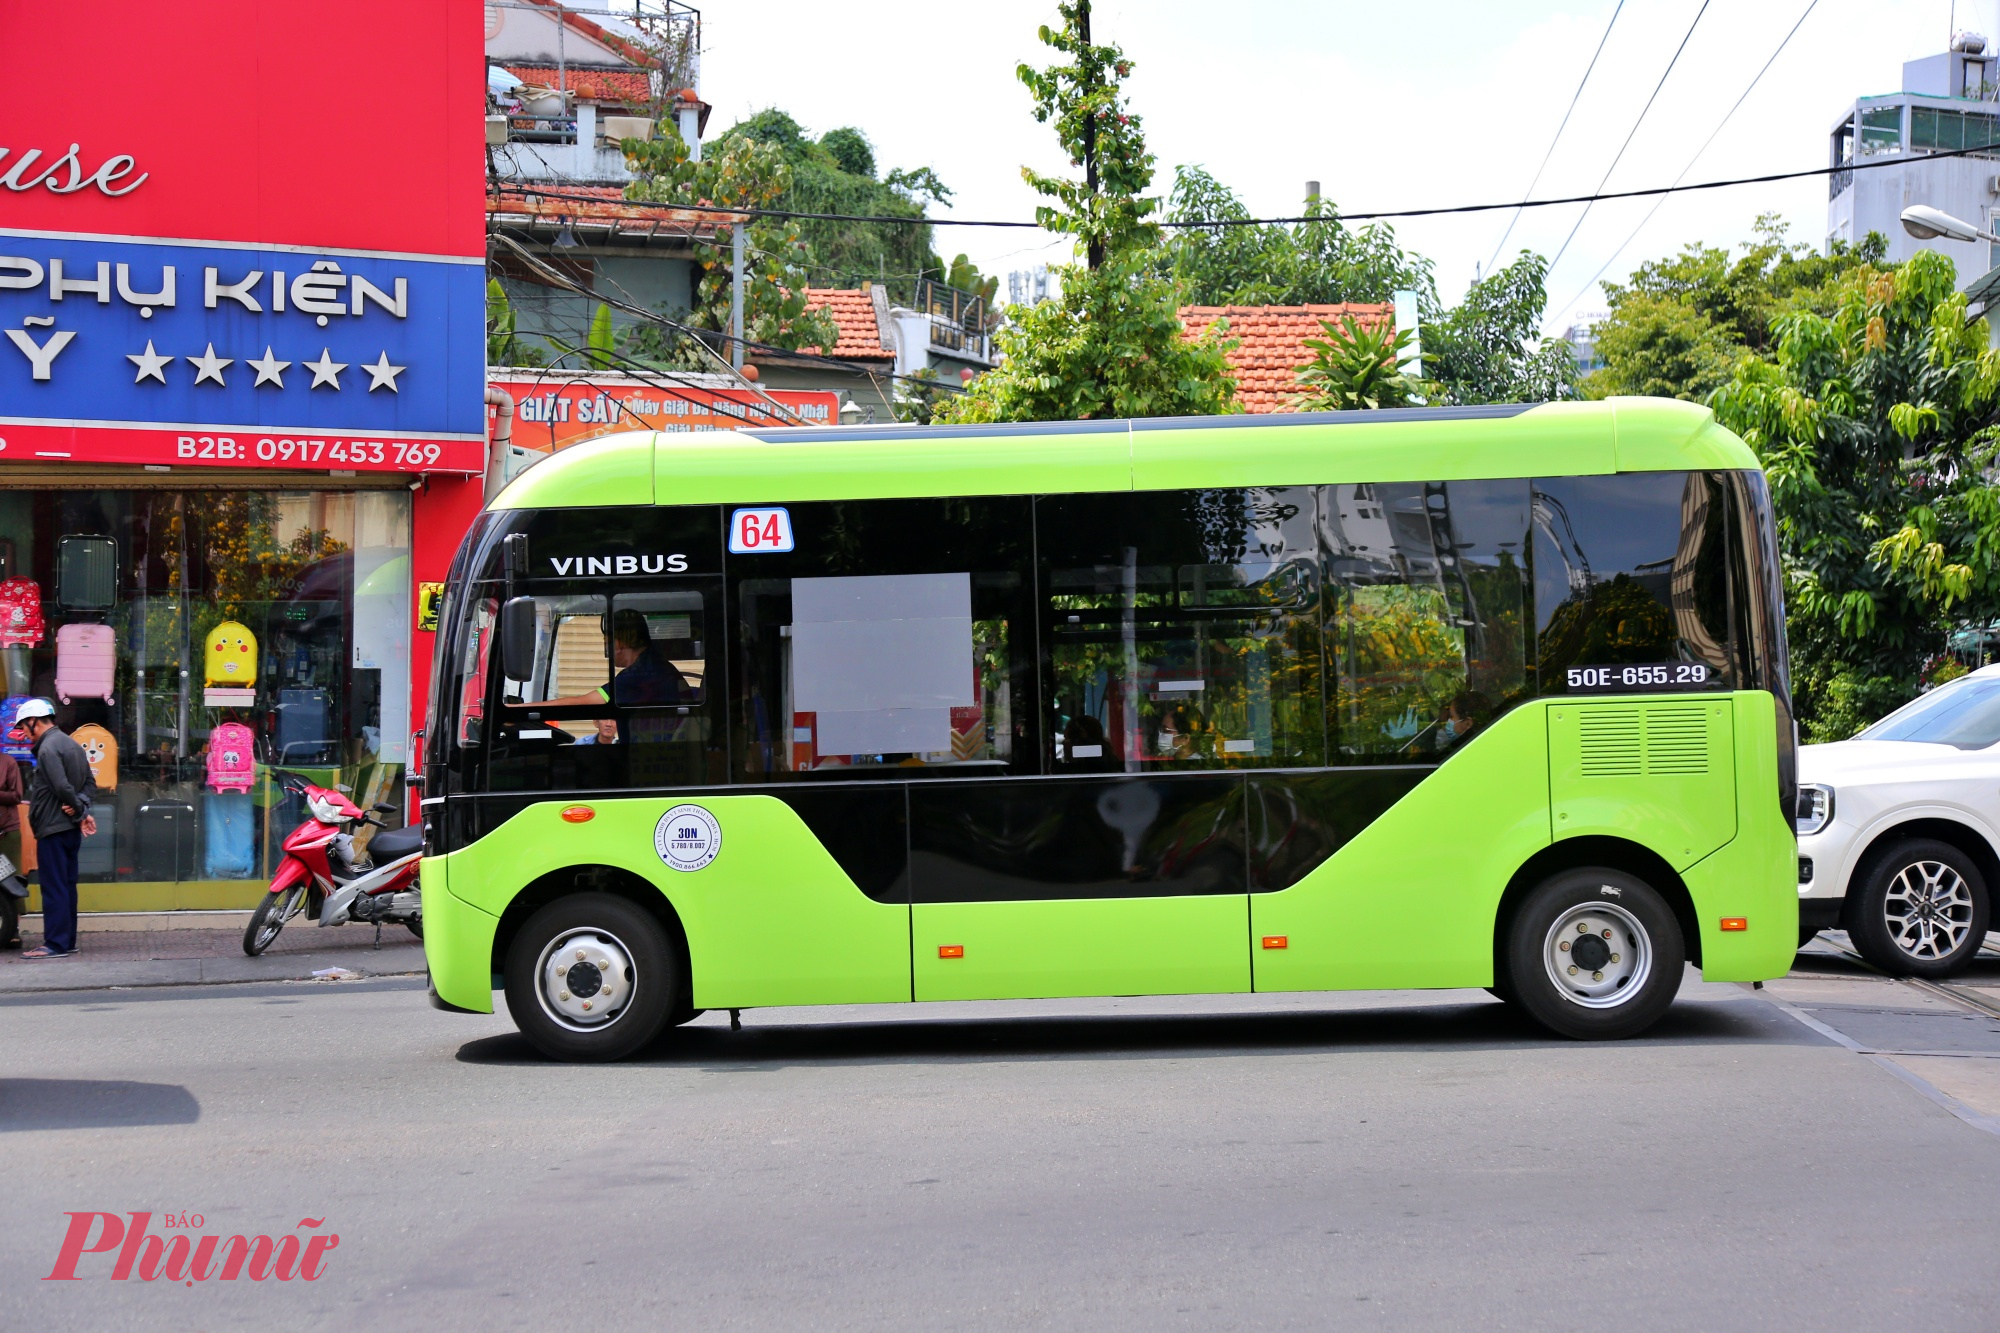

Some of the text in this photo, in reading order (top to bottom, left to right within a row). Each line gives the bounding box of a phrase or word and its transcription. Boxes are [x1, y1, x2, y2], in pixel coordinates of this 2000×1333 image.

[204, 260, 407, 327] KIỆN
[520, 390, 624, 427] GIẶT SẤY
[632, 398, 660, 416] Máy
[663, 400, 690, 418] Giặt
[799, 403, 829, 421] Nhật
[177, 436, 245, 460] B2B:
[392, 443, 441, 465] 769
[741, 513, 782, 547] 64
[550, 554, 689, 576] VINBUS
[1567, 665, 1706, 687] 50E-655.29
[678, 828, 697, 839] 30N
